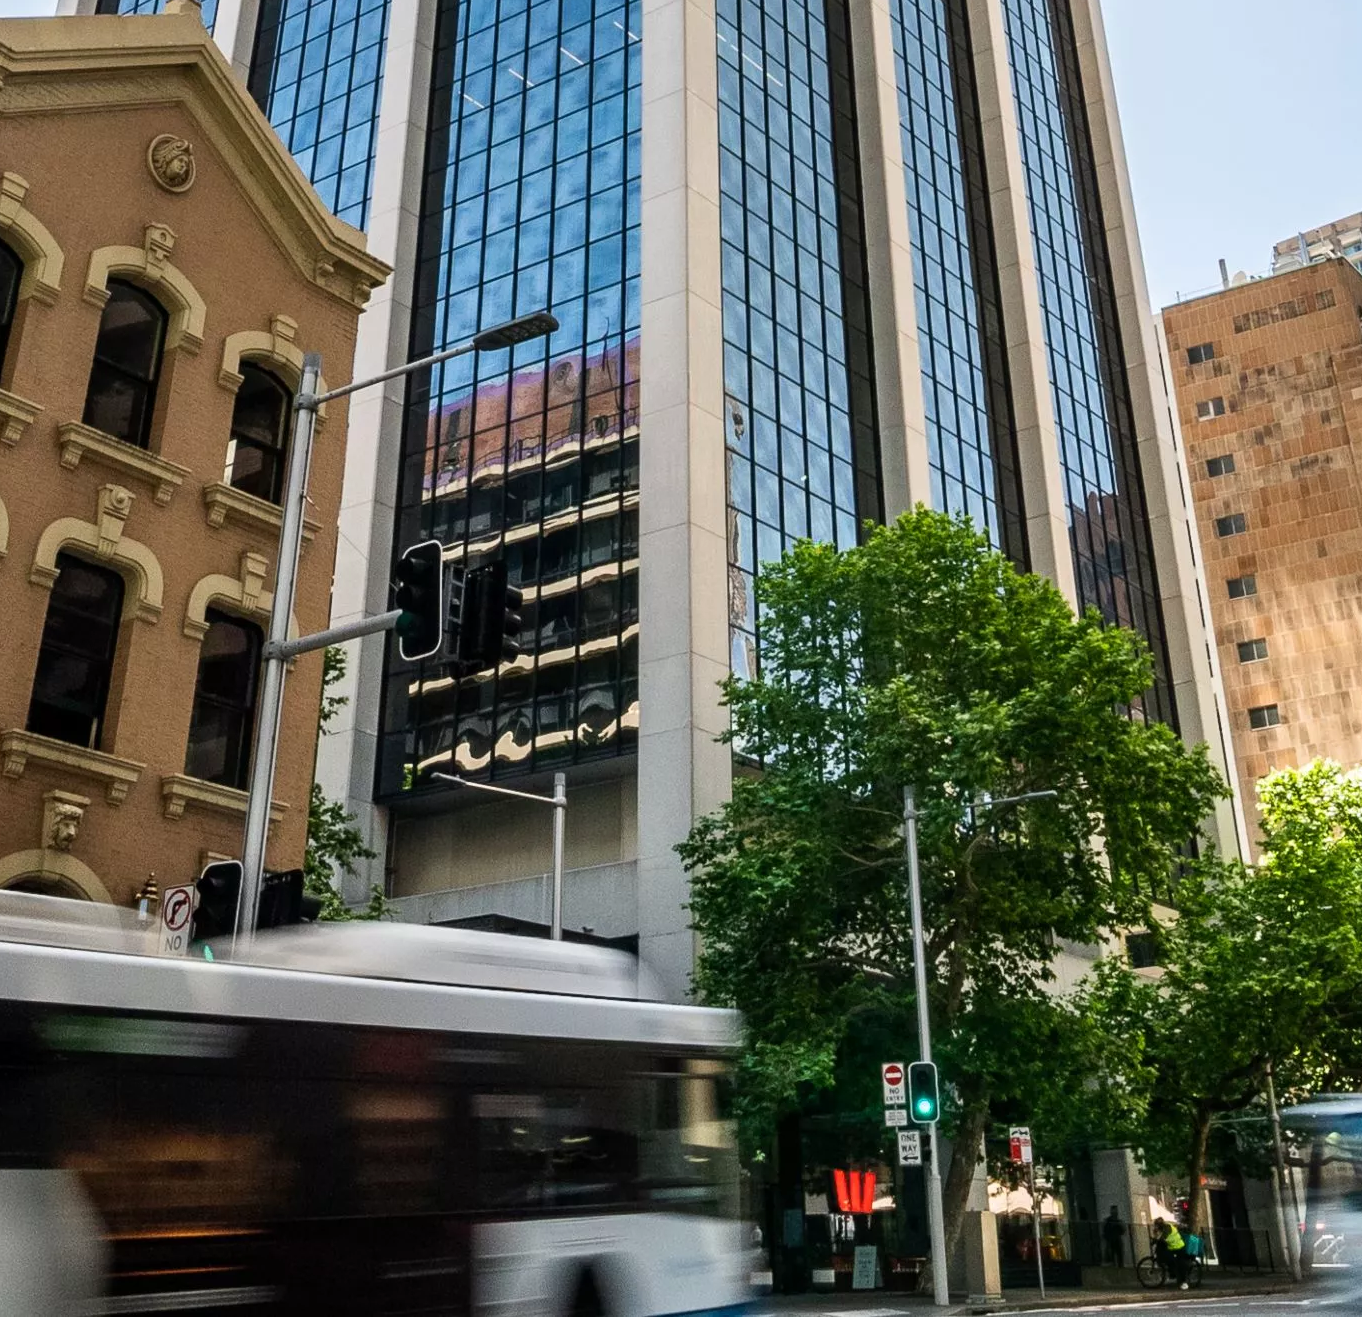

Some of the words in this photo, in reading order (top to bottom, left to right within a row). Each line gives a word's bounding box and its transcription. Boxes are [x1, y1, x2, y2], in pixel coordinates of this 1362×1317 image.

[165, 935, 182, 952] NO
[889, 1087, 900, 1095] NO
[901, 1134, 917, 1142] ONE
[901, 1145, 918, 1153] WAY
